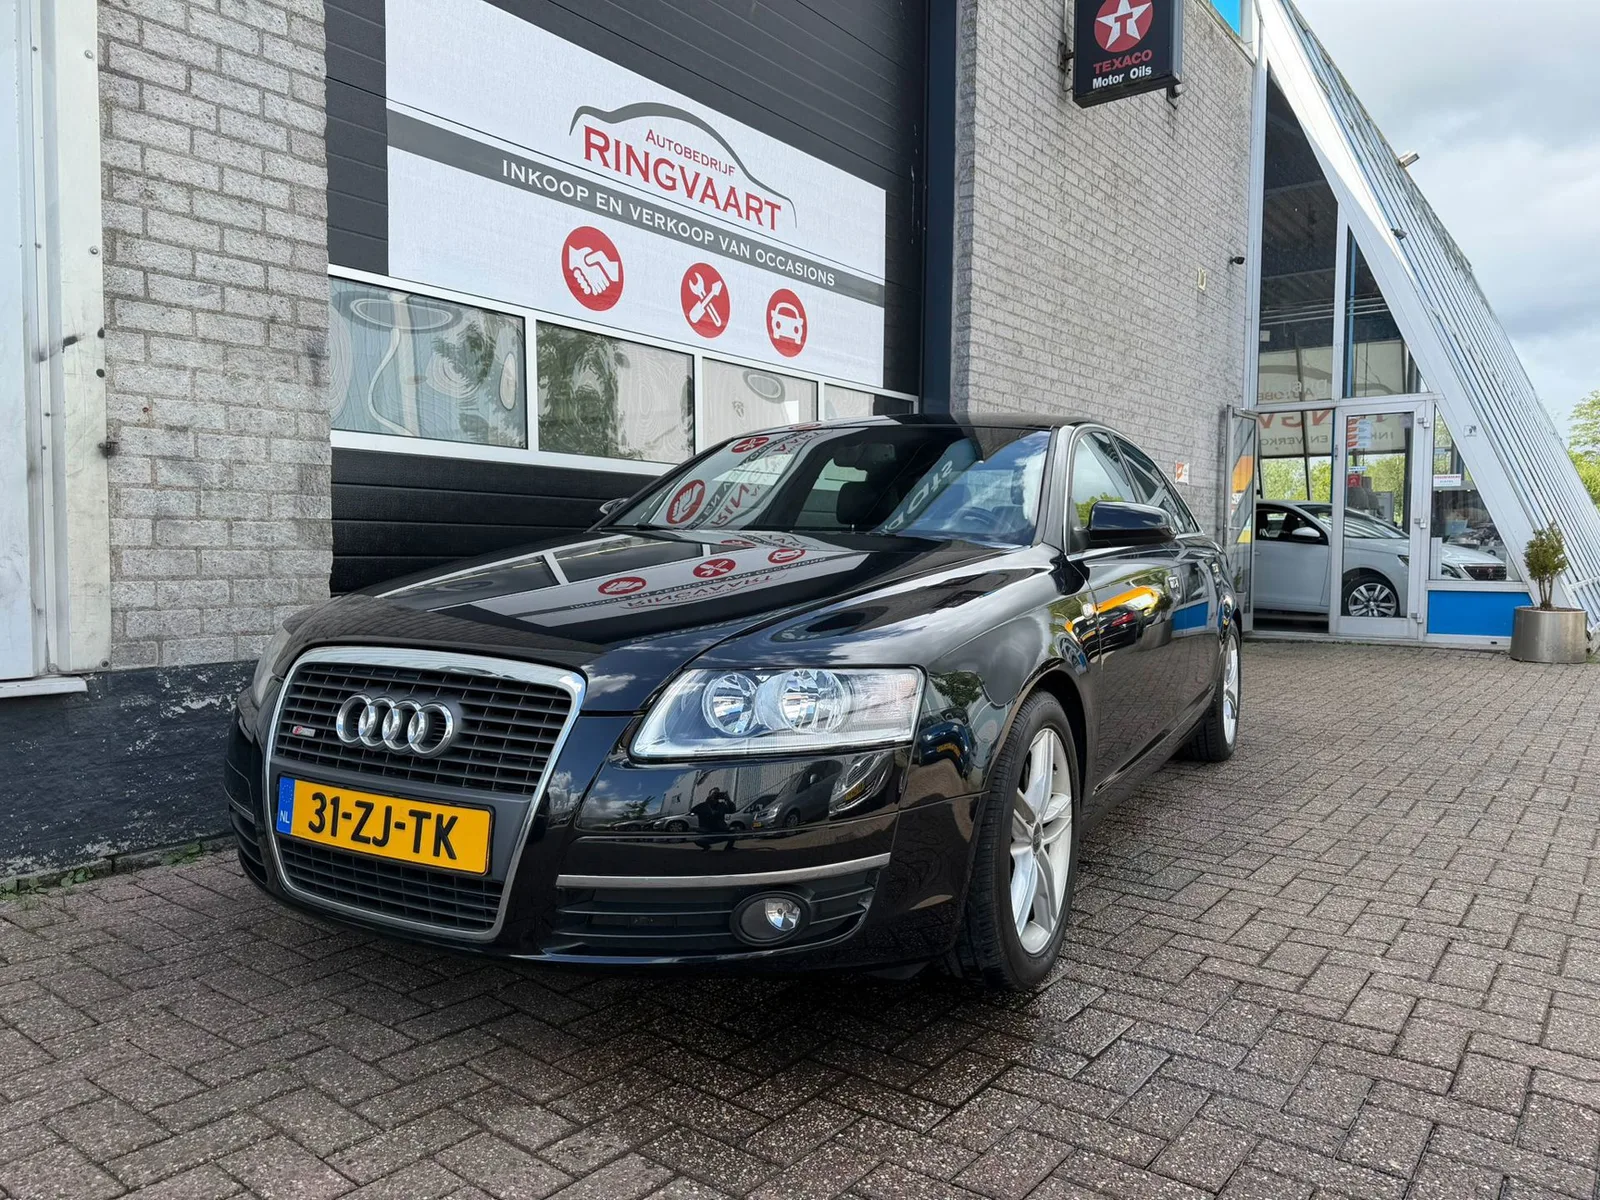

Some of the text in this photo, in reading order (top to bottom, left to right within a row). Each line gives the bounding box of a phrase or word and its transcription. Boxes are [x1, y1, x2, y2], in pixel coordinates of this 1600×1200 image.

[1092, 65, 1152, 90] Motor Oils
[1093, 49, 1153, 75] TEXACO
[645, 128, 736, 177] AUTOBEDRIJF
[583, 125, 782, 232] RINGVAART
[502, 159, 835, 287] INKOOP EN VERKOOP VAN OCCASIONS
[279, 809, 291, 824] NL
[308, 791, 459, 861] 31-ZJ-TK
